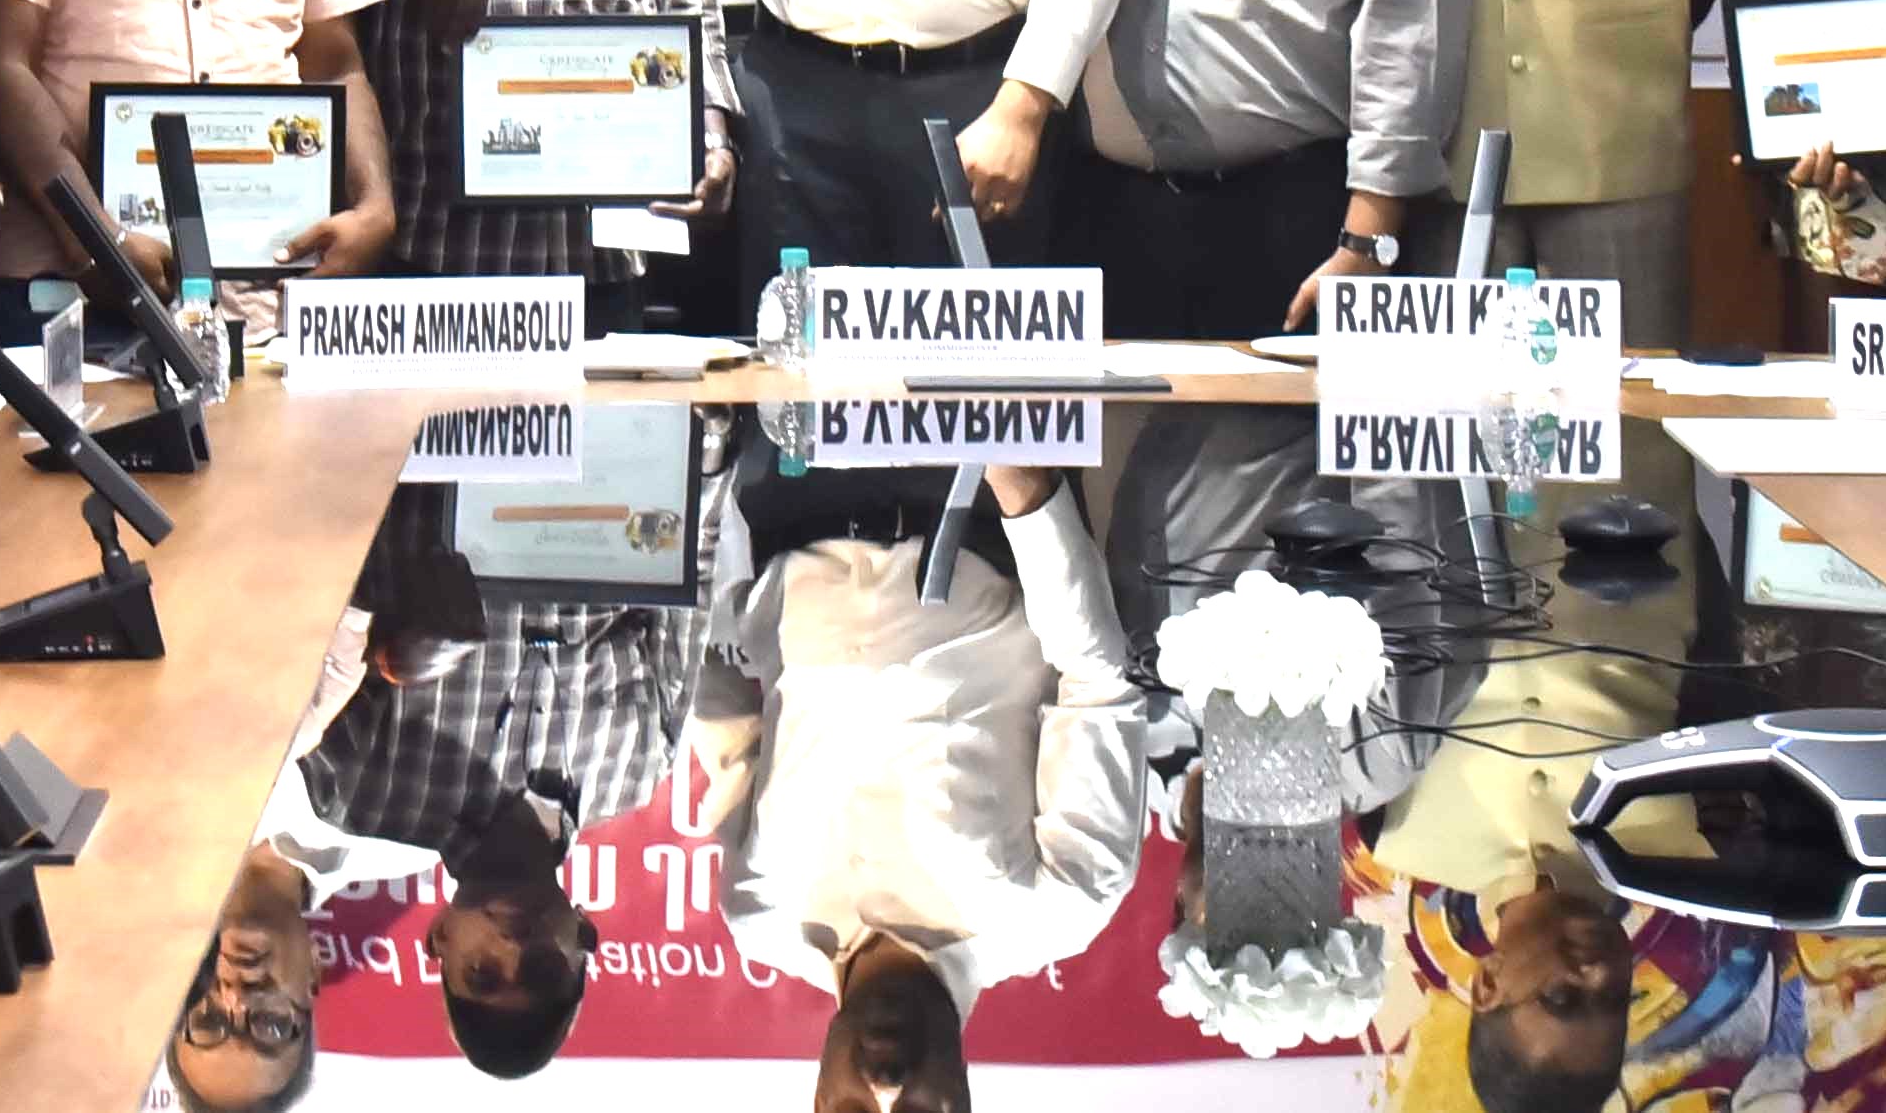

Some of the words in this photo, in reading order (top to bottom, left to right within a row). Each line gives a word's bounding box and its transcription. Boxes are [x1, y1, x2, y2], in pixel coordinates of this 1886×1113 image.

[300, 304, 405, 356] PRAKASH
[413, 301, 572, 354] AMMANABOLU
[823, 289, 1084, 341] R.V.KARNAN
[1335, 282, 1454, 335] R.RAVI
[1469, 284, 1602, 338] KAR
